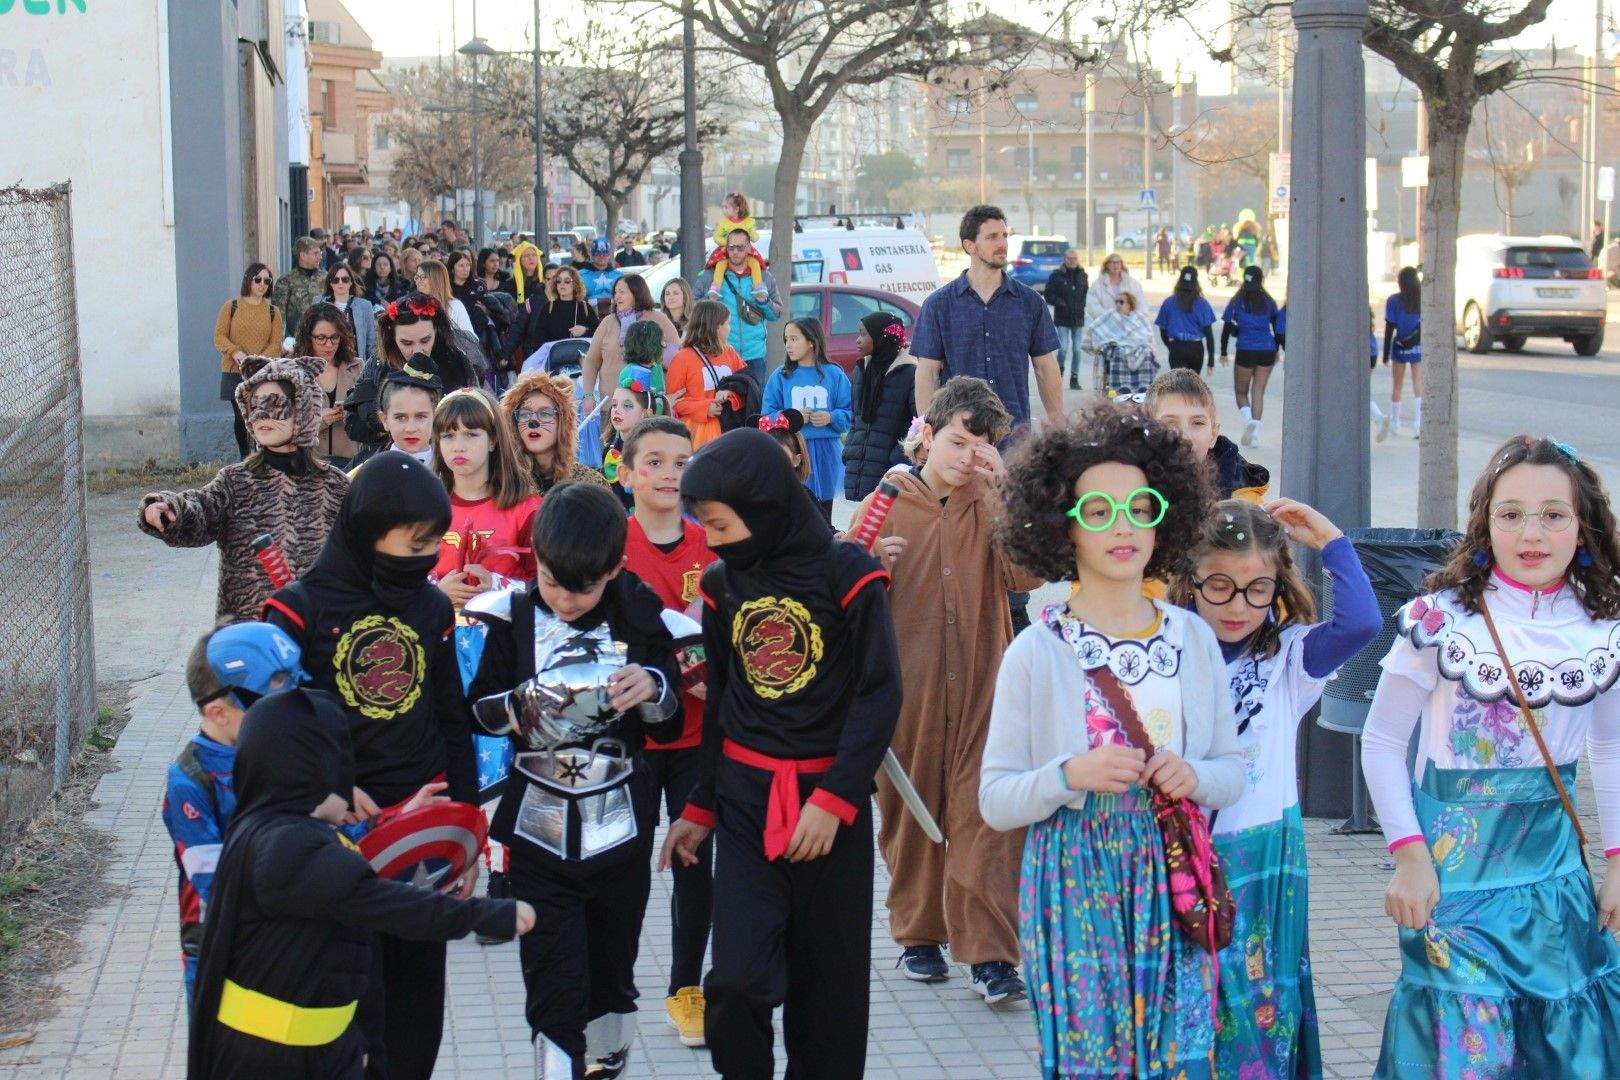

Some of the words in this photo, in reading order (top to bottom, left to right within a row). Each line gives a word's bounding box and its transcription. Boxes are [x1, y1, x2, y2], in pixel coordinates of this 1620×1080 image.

[869, 245, 927, 256] FONTANERIA
[875, 263, 893, 274] GAS
[791, 385, 829, 411] m
